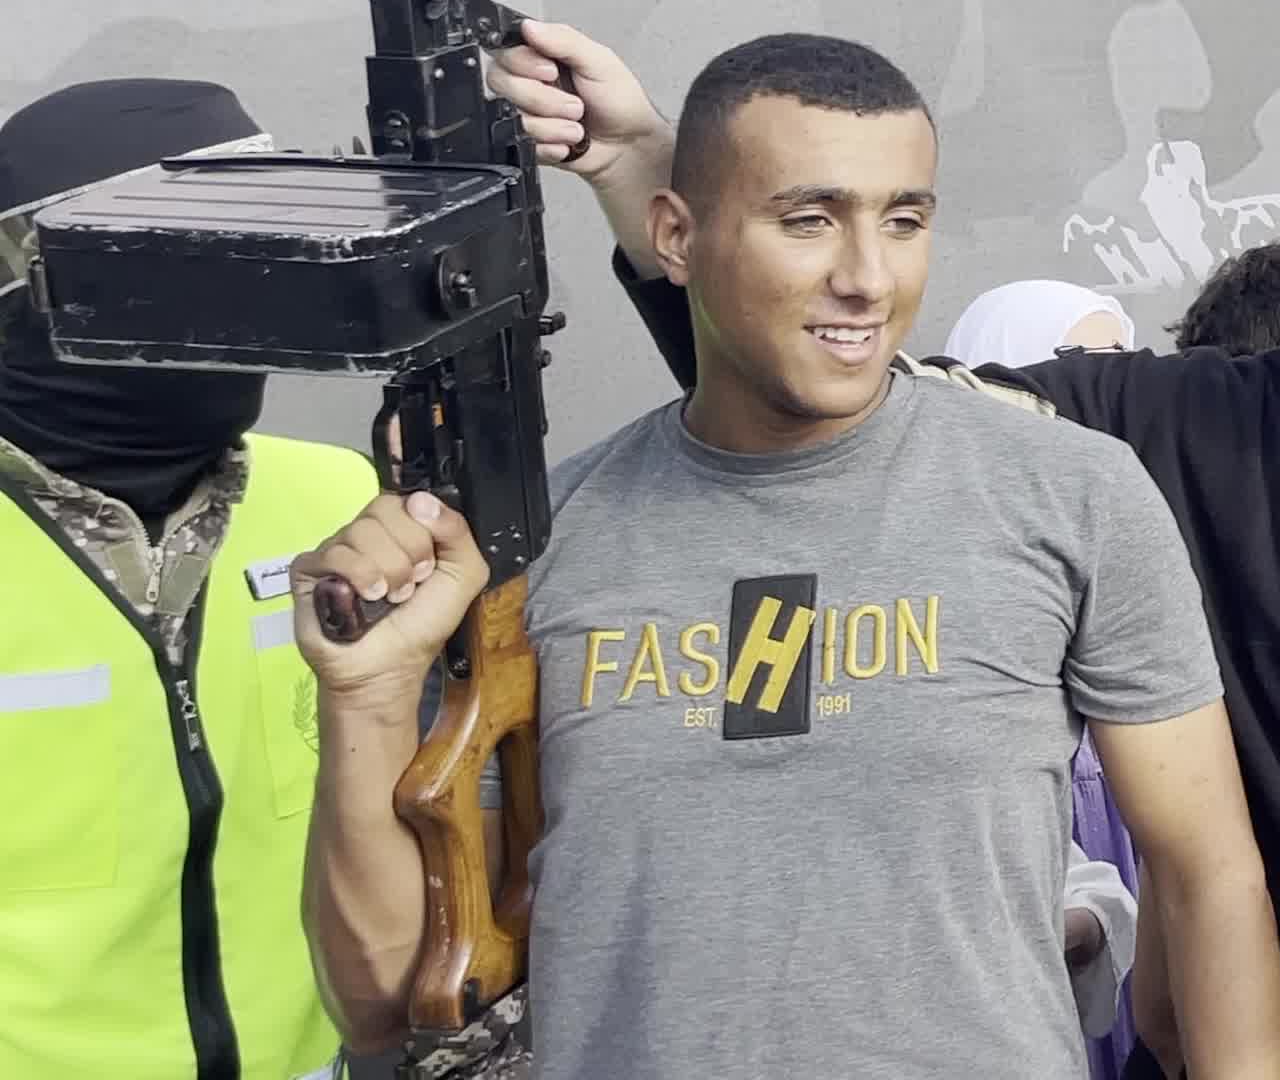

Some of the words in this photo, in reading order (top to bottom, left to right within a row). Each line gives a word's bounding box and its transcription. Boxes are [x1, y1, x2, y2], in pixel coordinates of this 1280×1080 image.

[581, 595, 941, 714] FASHION
[684, 706, 719, 729] EST.
[815, 694, 852, 719] 1991
